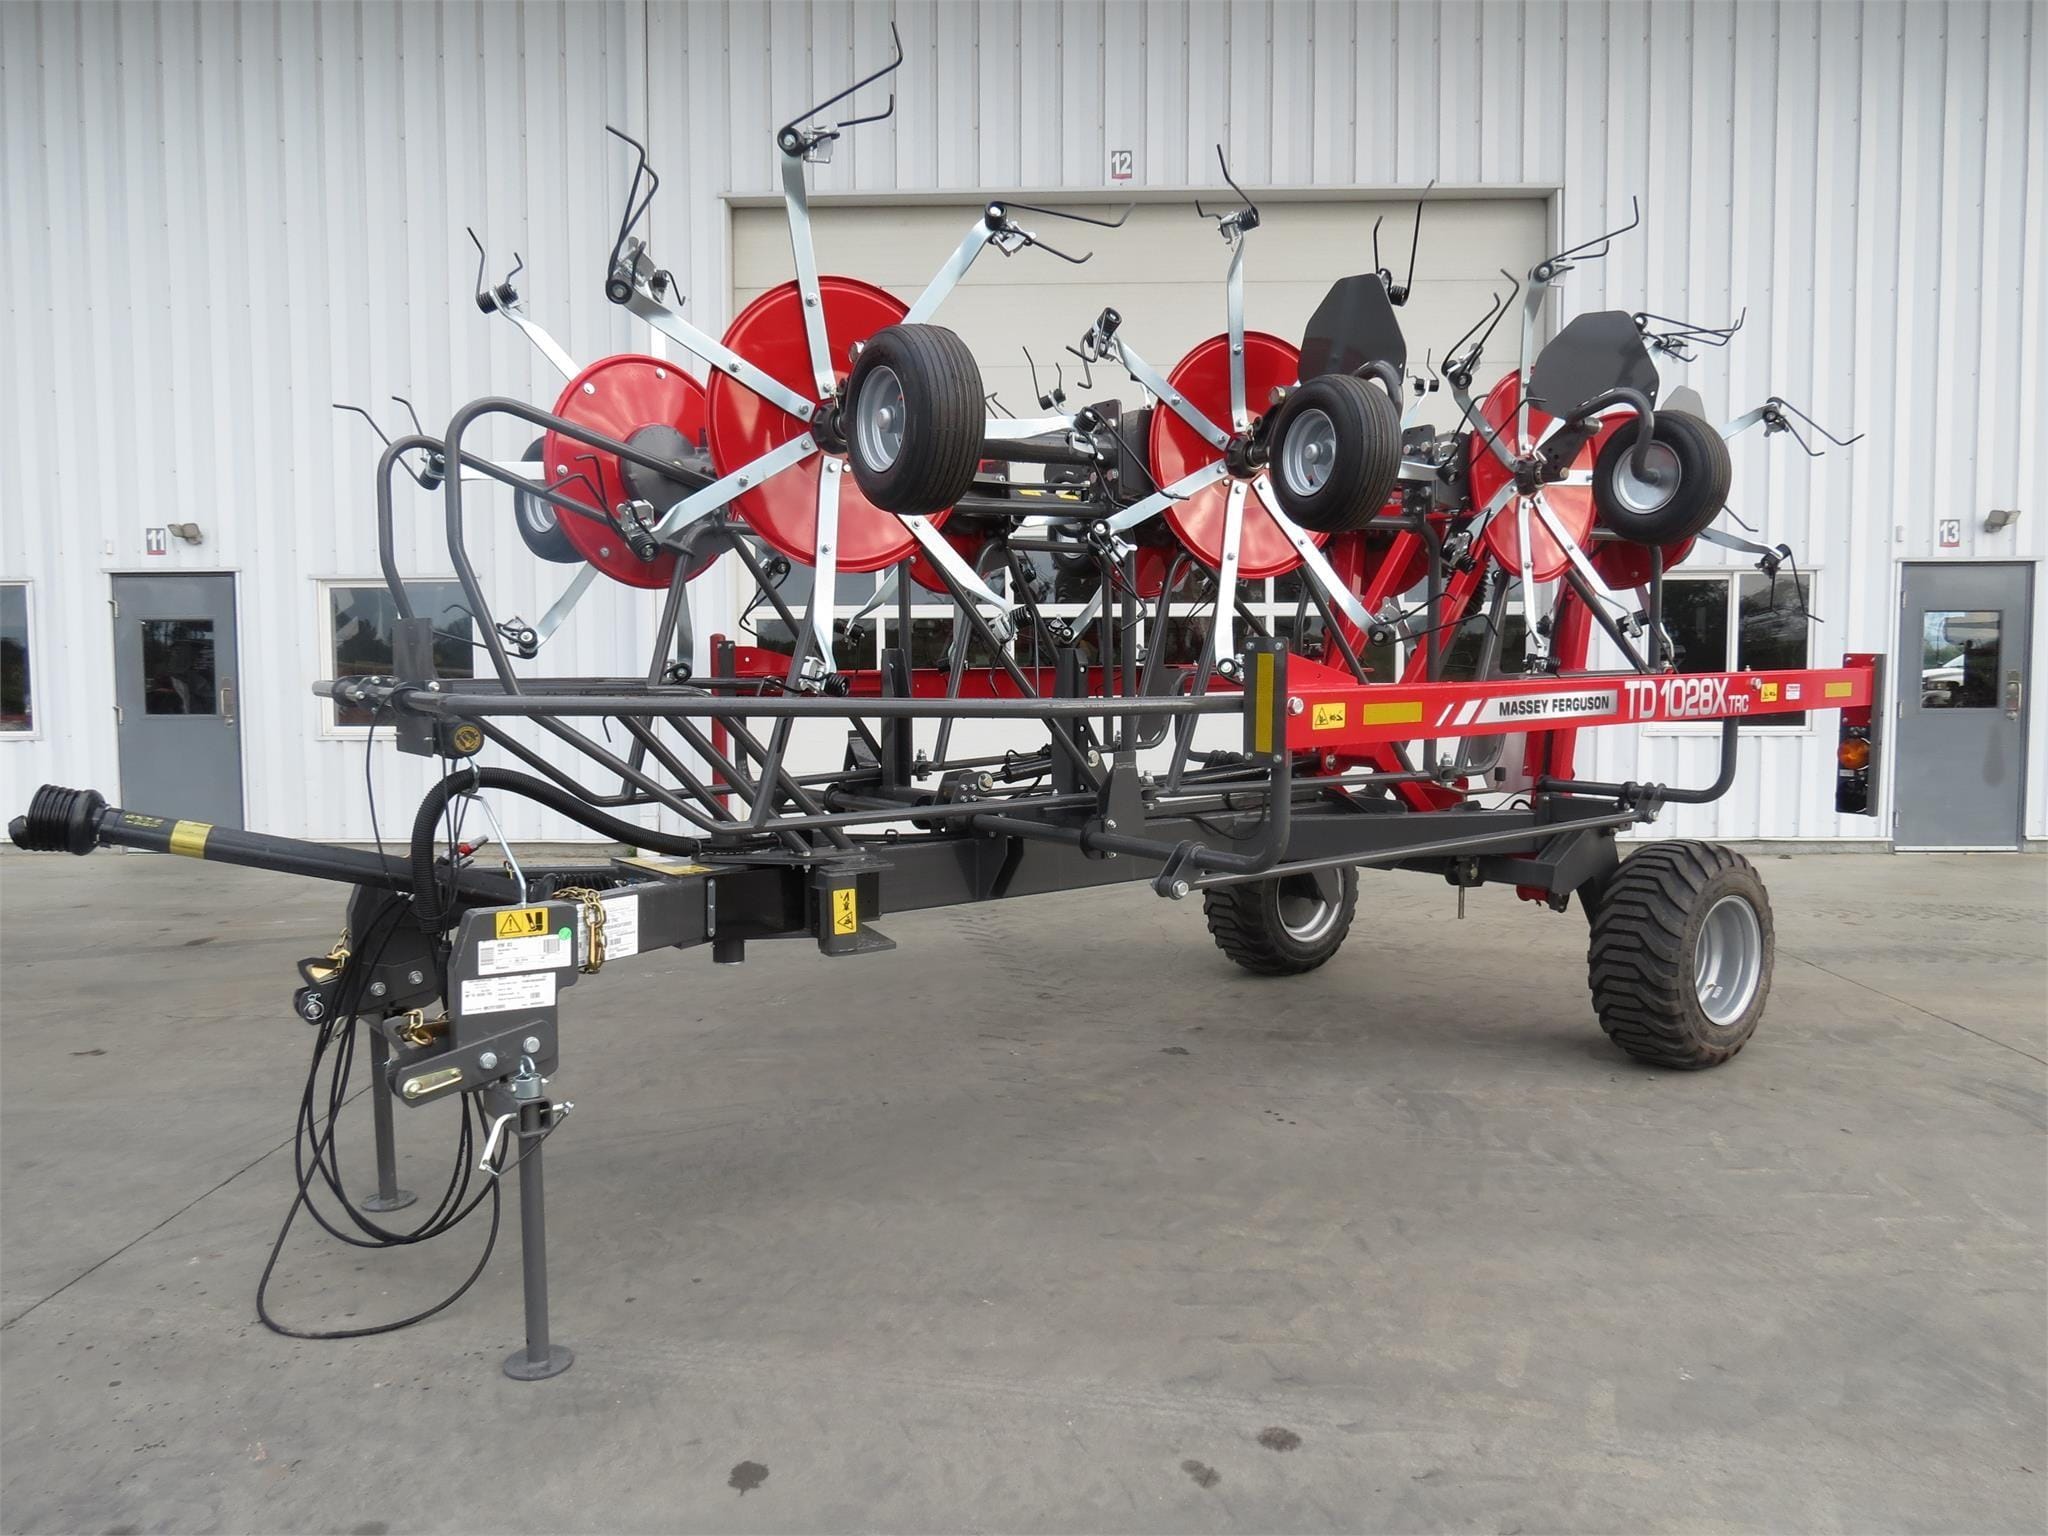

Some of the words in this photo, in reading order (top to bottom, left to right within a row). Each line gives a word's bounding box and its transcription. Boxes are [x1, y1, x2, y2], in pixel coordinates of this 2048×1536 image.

[1111, 152, 1131, 175] 12
[147, 529, 165, 551] 11
[1940, 521, 1959, 543] 13
[1499, 699, 1549, 716] MASSEY
[1552, 696, 1610, 713] FERGUSON
[1624, 680, 1657, 720] TD
[1660, 678, 1728, 717] 1028X
[1728, 694, 1749, 713] TRC
